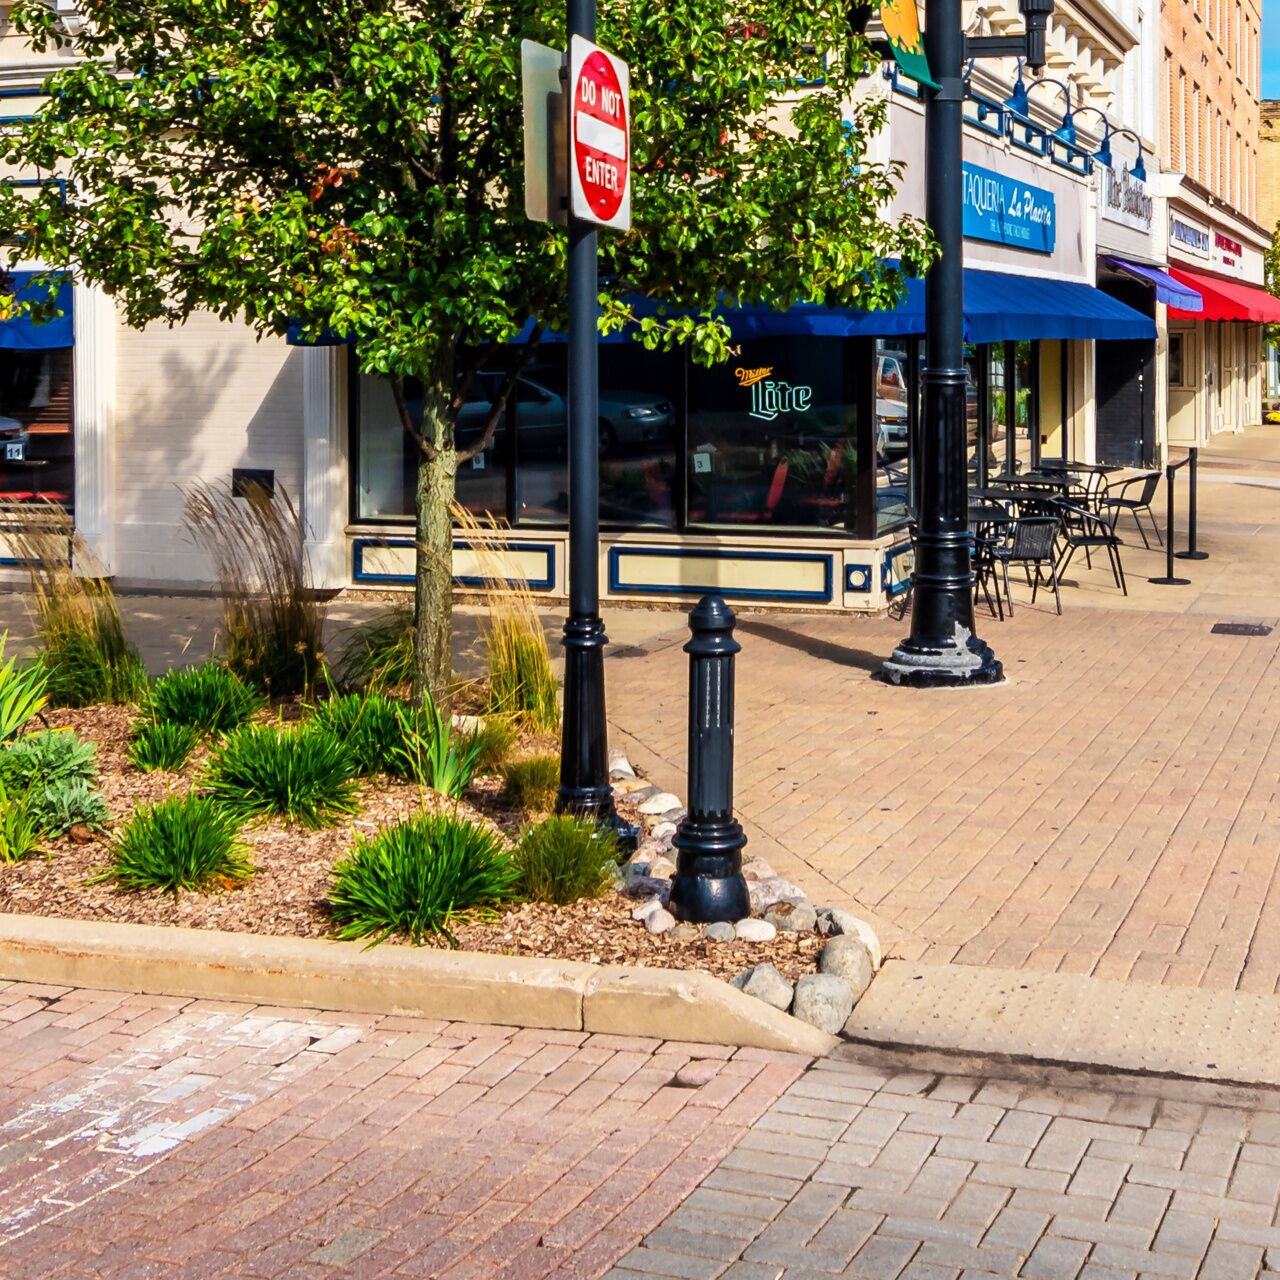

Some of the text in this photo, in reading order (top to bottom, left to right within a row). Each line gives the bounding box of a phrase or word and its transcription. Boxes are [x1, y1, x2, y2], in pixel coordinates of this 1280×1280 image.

[581, 76, 621, 119] DO NOT
[585, 156, 618, 192] ENTER
[961, 170, 1052, 227] TAQUERIA La Placita
[735, 367, 774, 386] Miller
[749, 380, 812, 421] Lite
